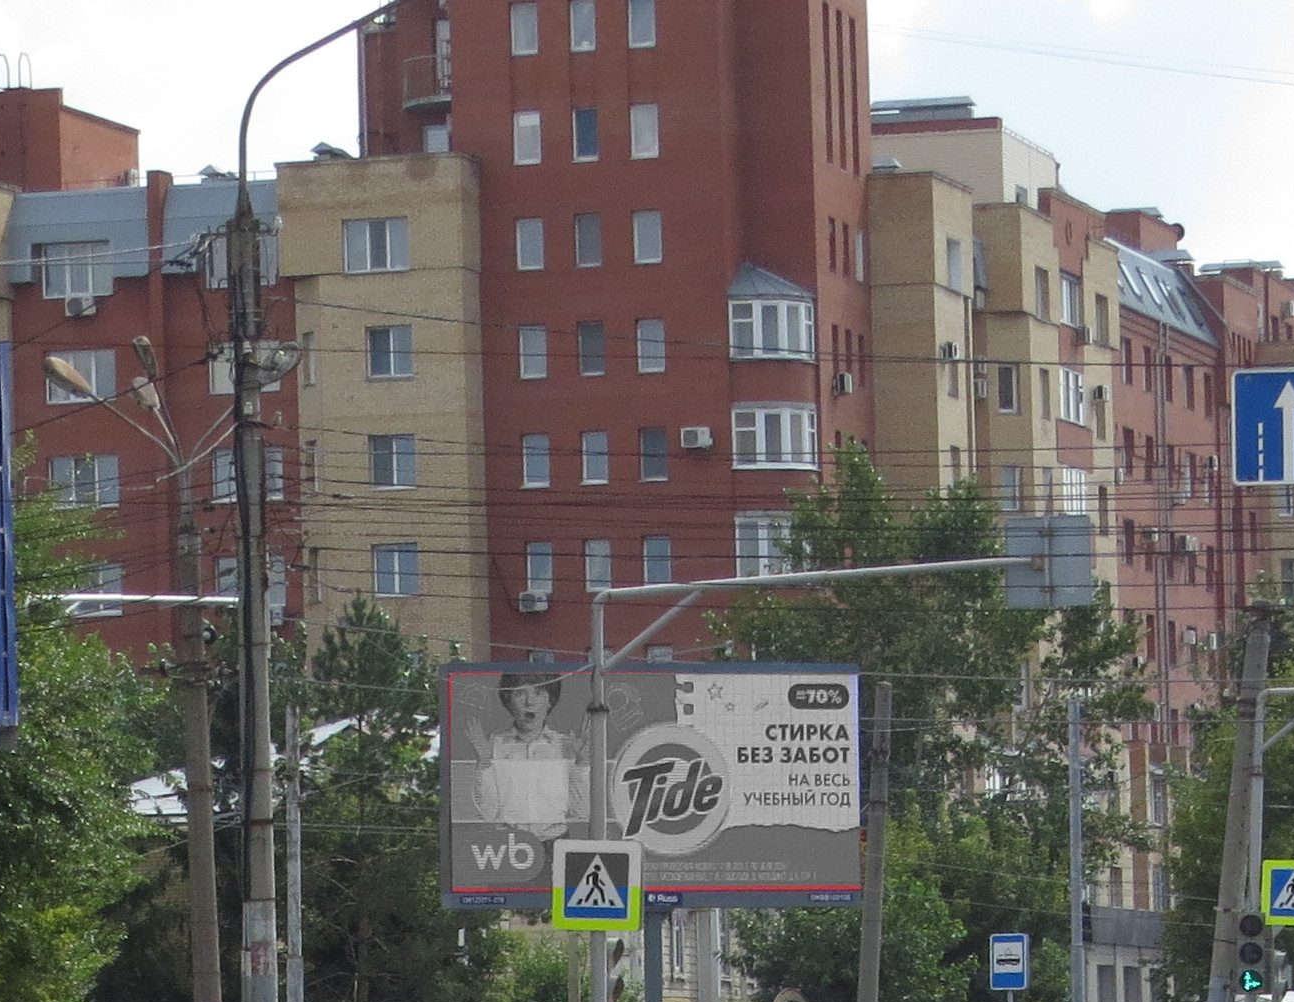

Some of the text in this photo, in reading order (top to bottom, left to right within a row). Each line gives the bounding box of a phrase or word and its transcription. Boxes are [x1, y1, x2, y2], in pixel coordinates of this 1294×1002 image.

[765, 724, 850, 741] СТИРКА
[737, 746, 851, 764] БЕЗ ЗАБОТ
[788, 773, 851, 787] НА ВЕСЬ
[622, 759, 723, 837] Tide
[743, 789, 851, 808] УЧЕБНЫЙ ГОД
[471, 833, 535, 870] wb
